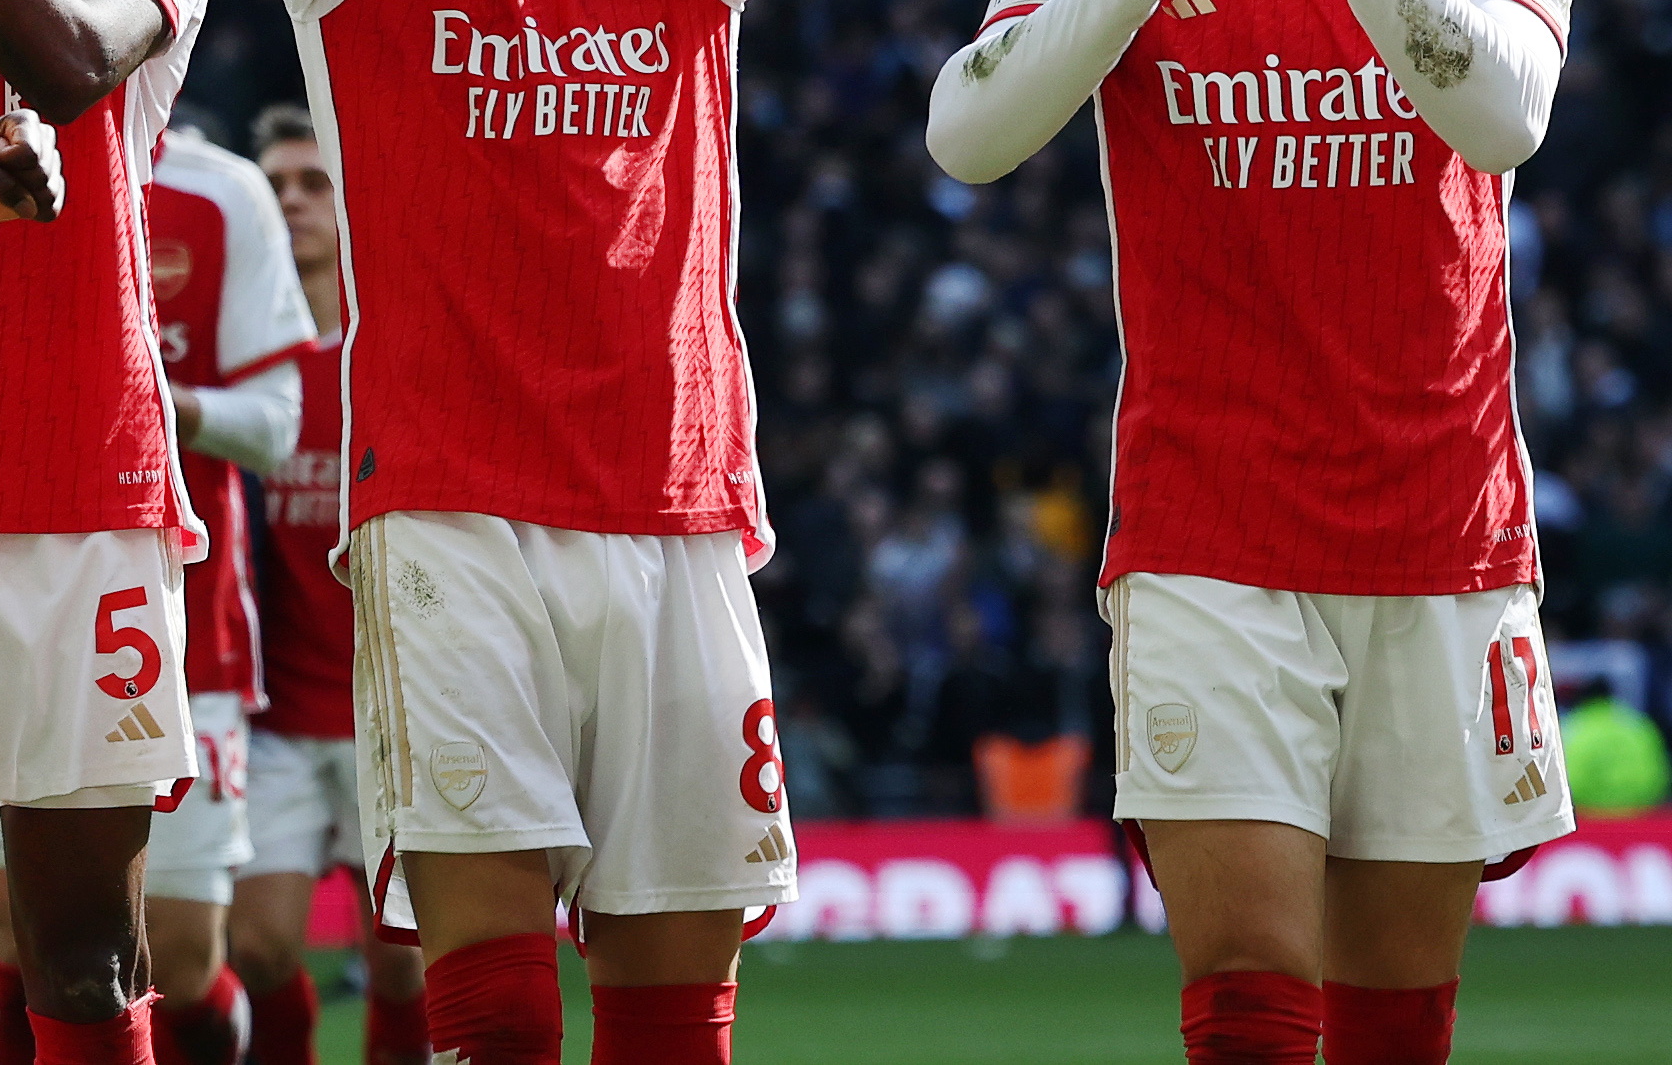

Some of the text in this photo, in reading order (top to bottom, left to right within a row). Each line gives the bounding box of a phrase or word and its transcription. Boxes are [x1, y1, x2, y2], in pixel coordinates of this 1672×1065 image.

[432, 9, 670, 82] Emirates
[465, 83, 651, 140] FLY BETTER
[1155, 54, 1418, 125] Emirate
[1272, 132, 1415, 189] BETTER
[118, 469, 163, 485] HEAT.RDY
[94, 586, 162, 700] 5
[739, 698, 786, 814] 8
